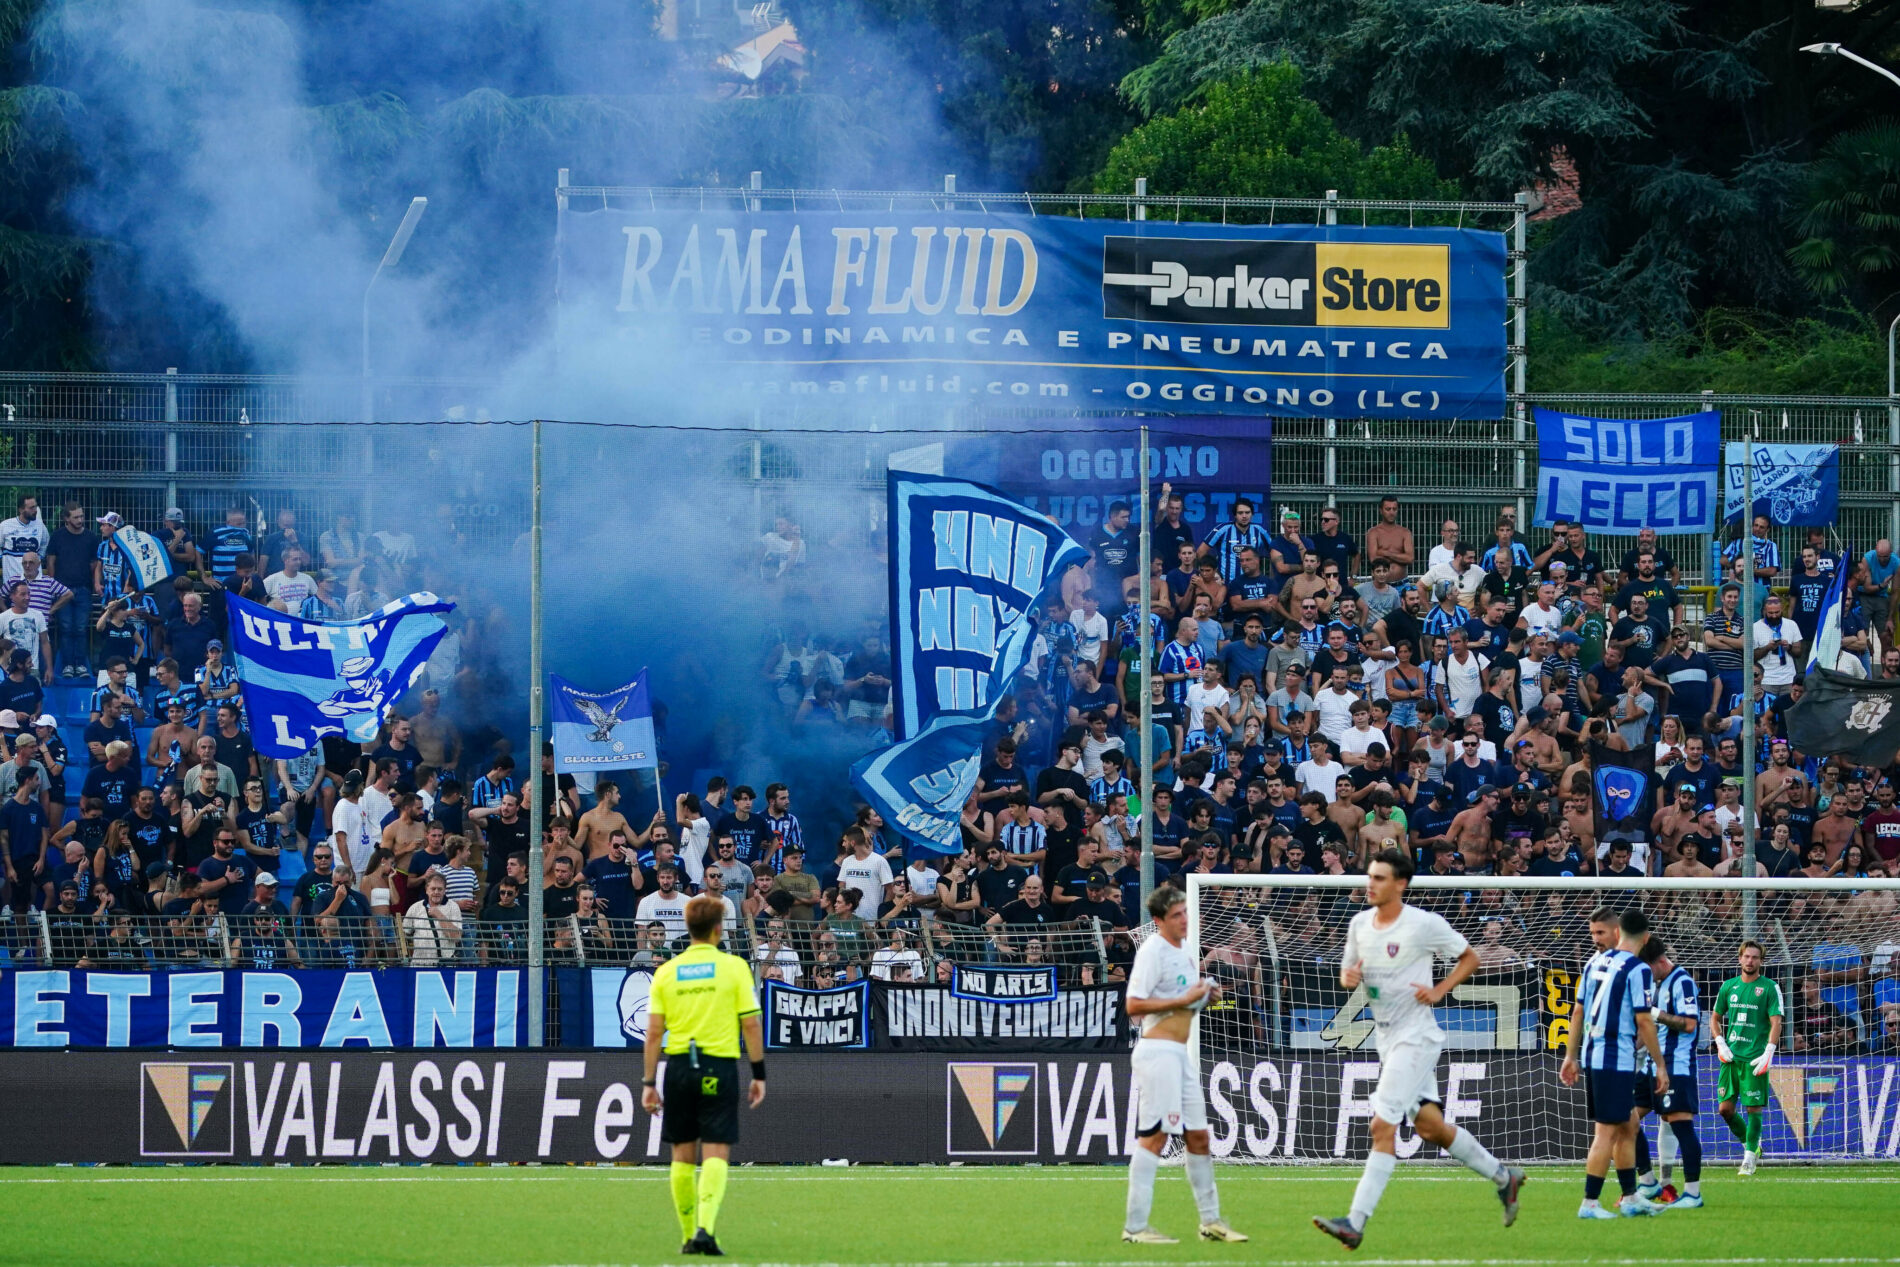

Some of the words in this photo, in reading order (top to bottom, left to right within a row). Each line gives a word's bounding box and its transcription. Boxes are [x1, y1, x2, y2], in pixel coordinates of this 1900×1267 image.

[616, 223, 813, 315] RAMA
[826, 226, 1039, 316] FLUID
[1150, 260, 1310, 310] Parker
[1322, 265, 1441, 312] Store
[616, 326, 1030, 347] OEODINAMICA
[1058, 330, 1080, 348] E
[1108, 332, 1449, 360] PNEUMATICA
[1126, 382, 1334, 407] OGGIONO
[1357, 389, 1441, 411] (LC)
[1041, 445, 1220, 481] OGGIONO
[1562, 417, 1694, 466] SOLO
[1763, 466, 1791, 487] CARRO
[1545, 475, 1707, 528] LECCO
[931, 510, 1048, 599] UNO
[564, 752, 646, 764] BLUCELESTE
[776, 991, 858, 1018] GRAPPA
[961, 970, 987, 994] NO
[1591, 971, 1612, 1017] 7
[2, 970, 520, 1047] ETERANI
[780, 1019, 792, 1043] E
[800, 1018, 854, 1045] VINCI
[244, 1060, 505, 1158] VALASSI
[1048, 1061, 1302, 1158] VALSSI
